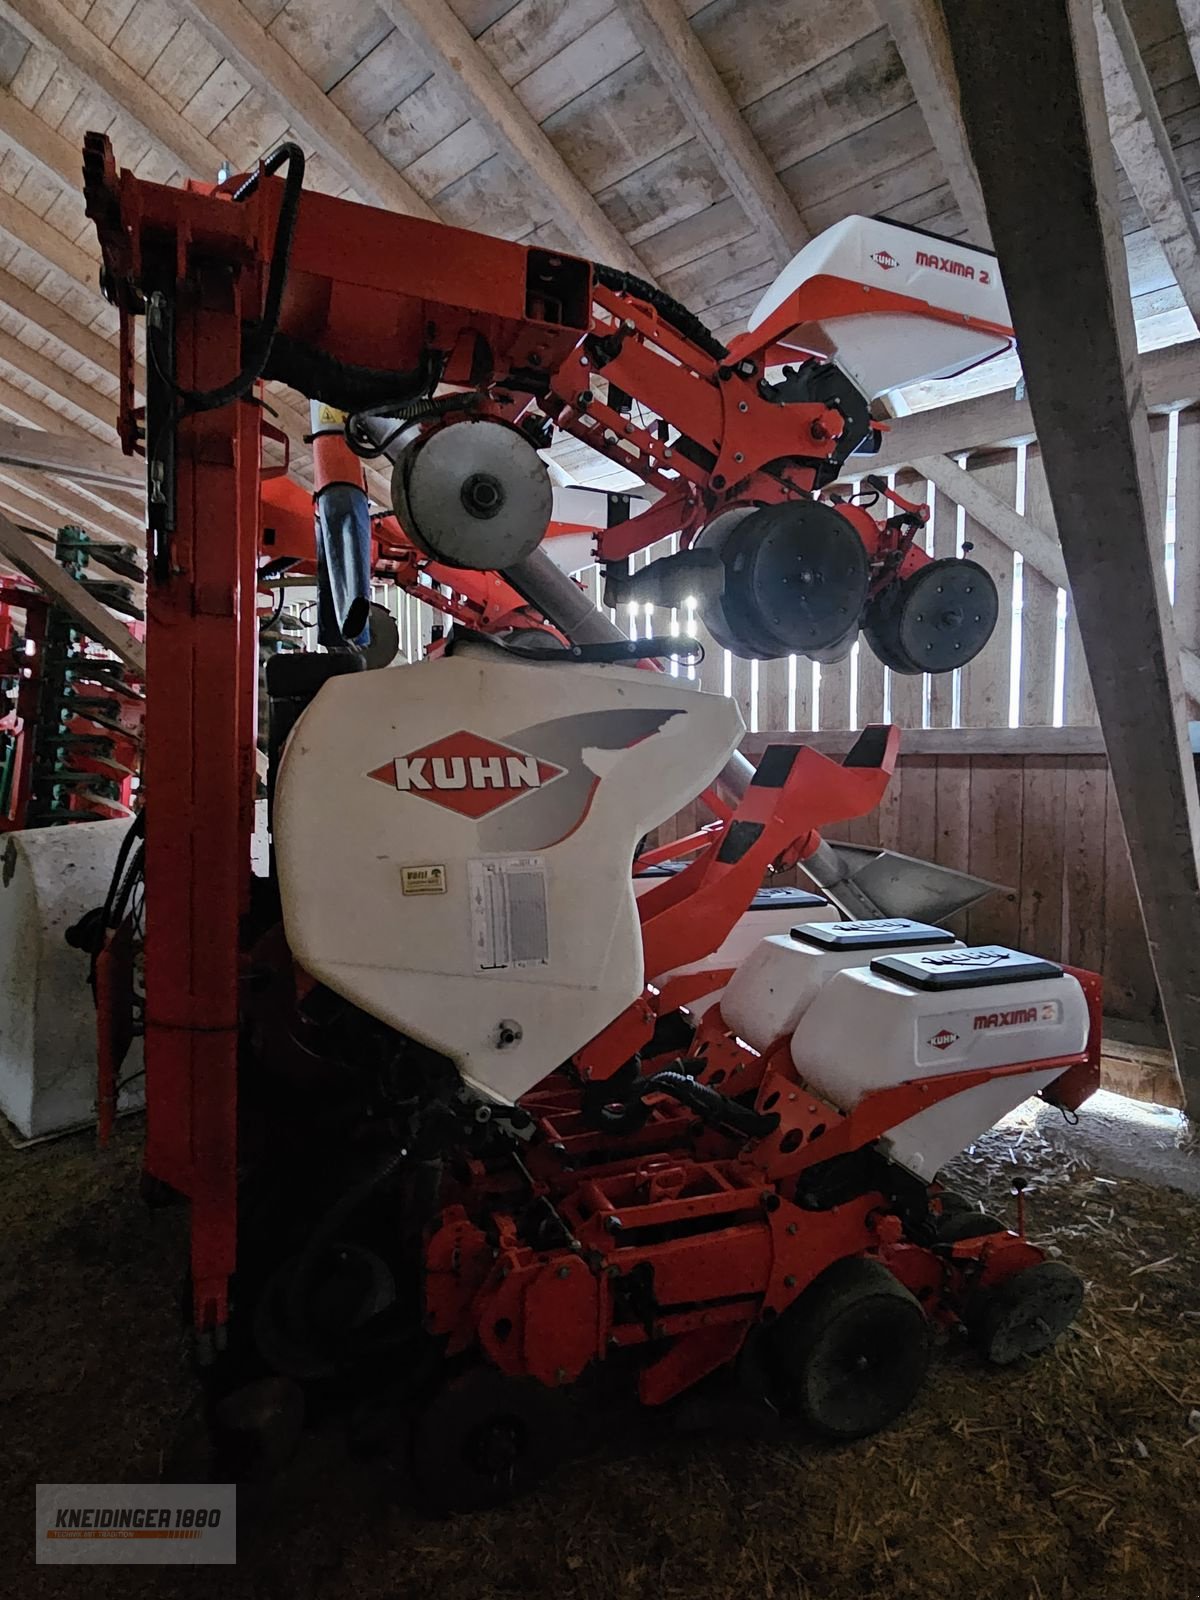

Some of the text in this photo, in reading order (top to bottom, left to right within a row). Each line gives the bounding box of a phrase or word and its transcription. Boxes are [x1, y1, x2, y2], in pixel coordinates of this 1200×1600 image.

[873, 253, 897, 268] KUHN
[915, 251, 990, 285] MAXIMA 2
[394, 757, 541, 791] KUHN
[973, 1007, 1038, 1031] MAXIMA
[930, 1033, 958, 1046] KUHN
